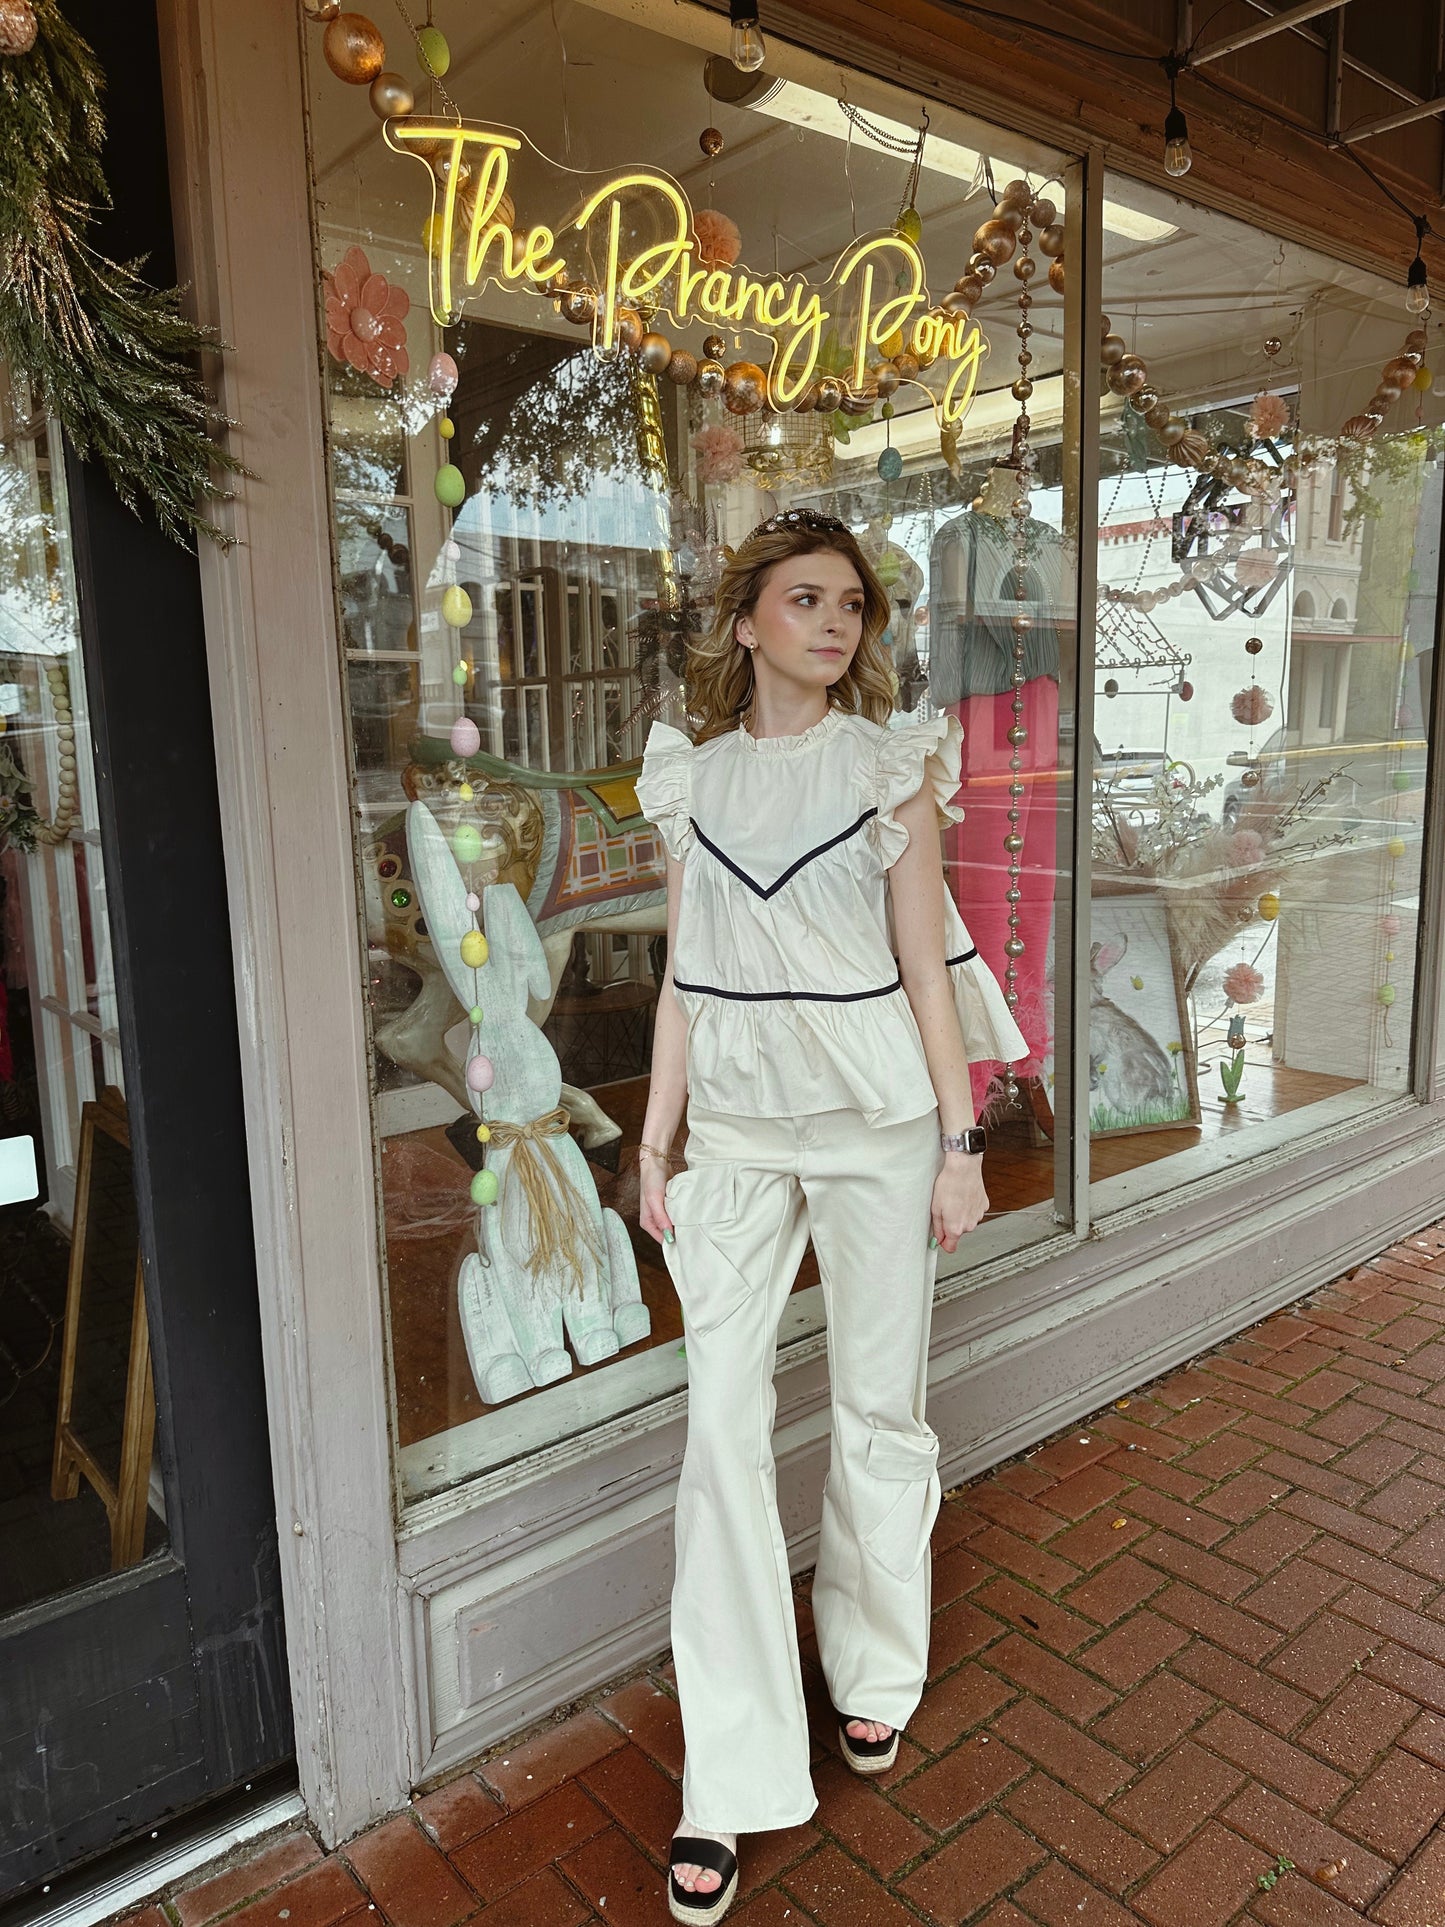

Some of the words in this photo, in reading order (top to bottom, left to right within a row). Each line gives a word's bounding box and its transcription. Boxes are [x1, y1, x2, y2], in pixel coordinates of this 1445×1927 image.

[395, 127, 566, 313] The
[576, 174, 829, 402] Prancy
[839, 237, 987, 422] Pony
